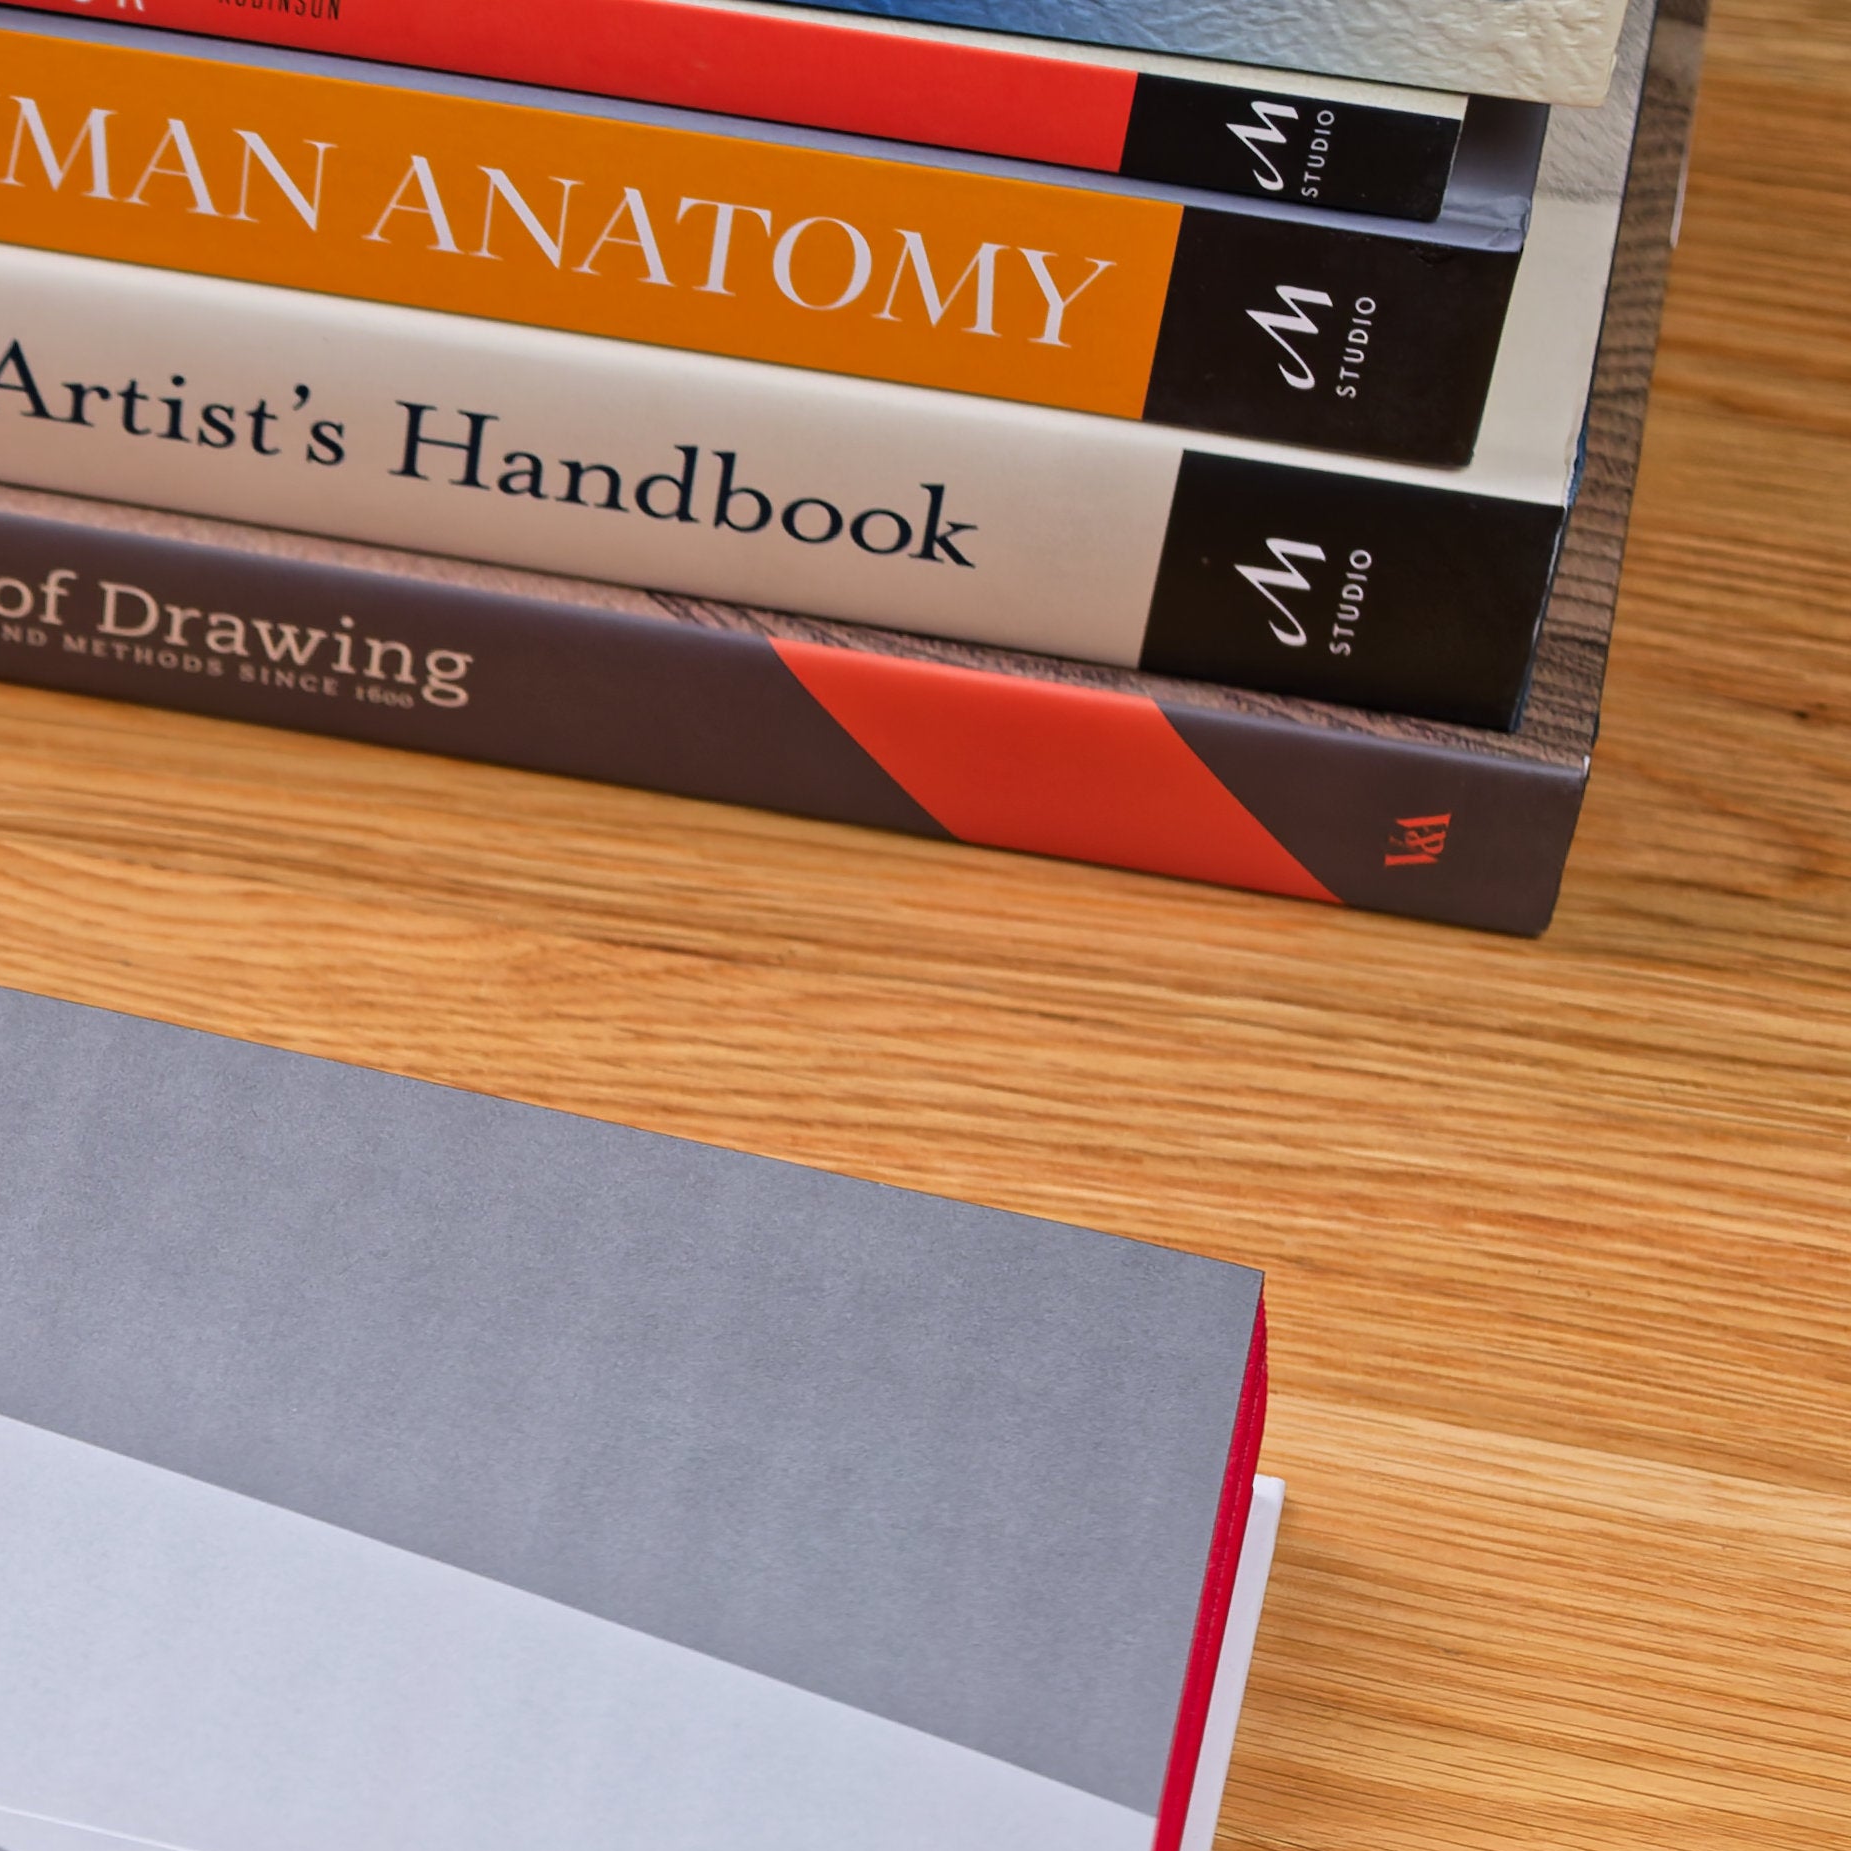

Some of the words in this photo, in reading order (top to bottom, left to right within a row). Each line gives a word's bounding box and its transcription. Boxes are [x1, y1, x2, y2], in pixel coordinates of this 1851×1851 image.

[1302, 110, 1335, 199] STUDIO
[361, 155, 1116, 348] ANATOMY
[1336, 295, 1378, 399] STUDIO
[388, 401, 978, 569] Handbook
[99, 581, 473, 709] Drawing
[1328, 548, 1373, 657] STUDIO
[63, 634, 223, 678] METHODS
[238, 665, 339, 697] SINCE
[1384, 812, 1452, 867] V&A
